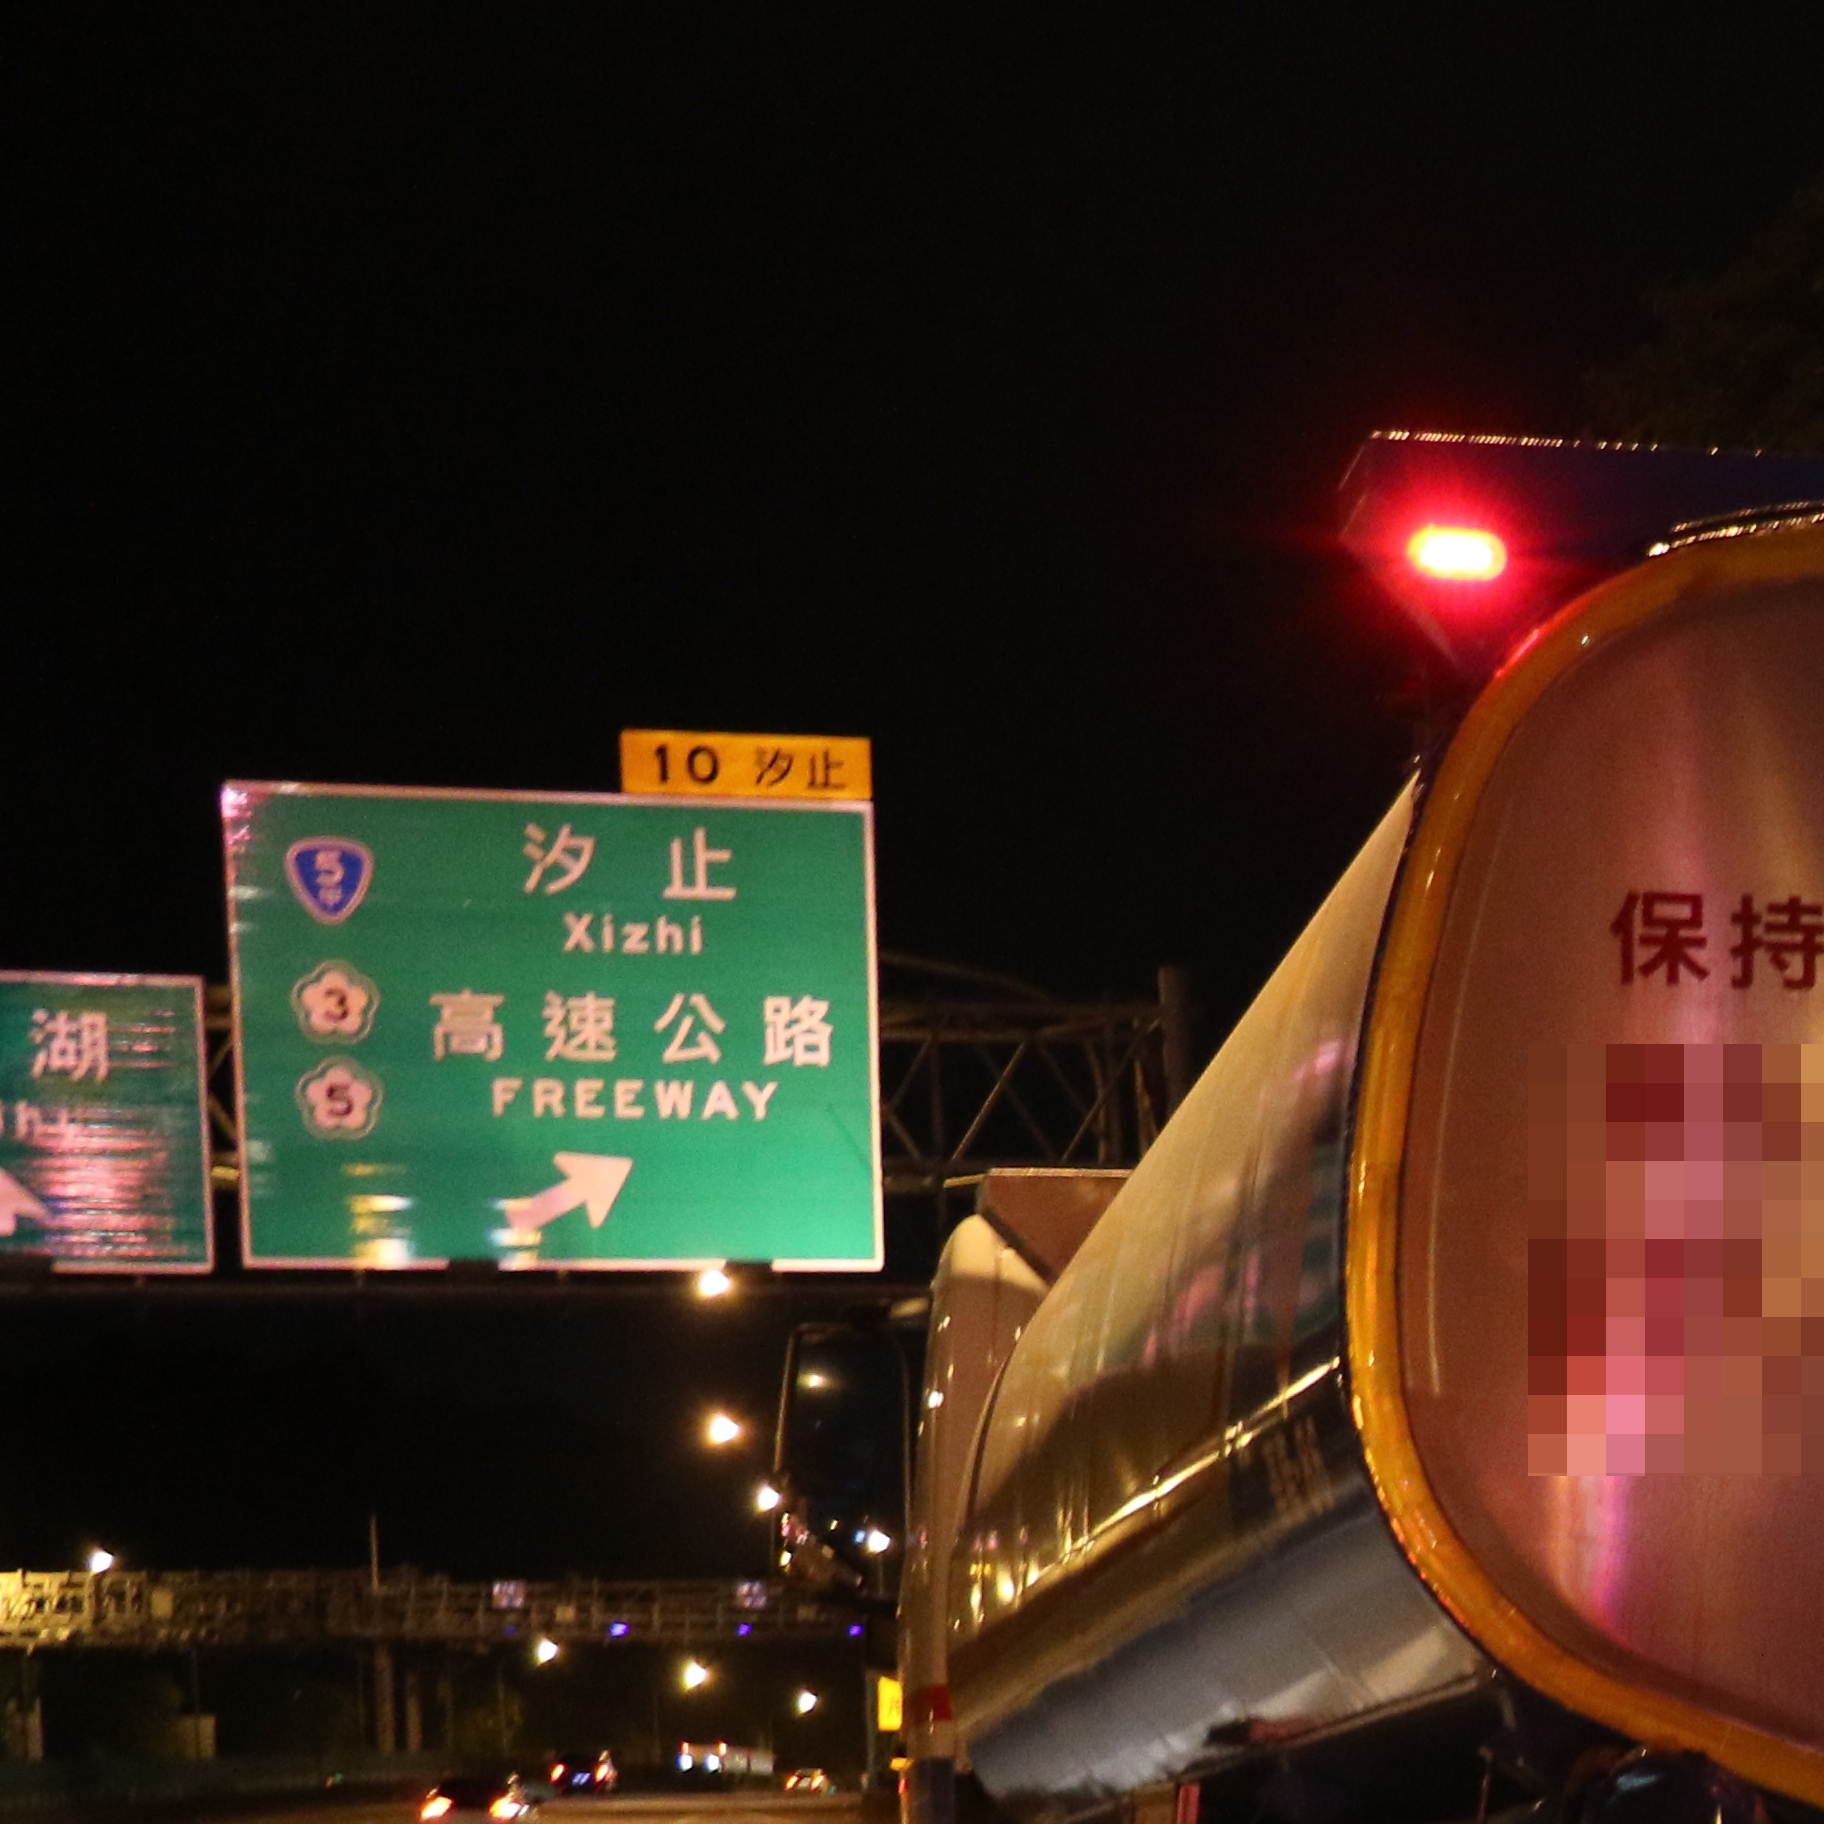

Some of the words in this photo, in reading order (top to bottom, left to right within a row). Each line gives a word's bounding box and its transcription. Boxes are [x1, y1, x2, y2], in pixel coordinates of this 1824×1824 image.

[655, 744, 720, 785] 10
[754, 747, 846, 790] 汐止
[522, 822, 738, 900] 汐止
[563, 911, 705, 955] Xizhi
[324, 988, 349, 1022] 3
[429, 987, 834, 1067] 高速公路
[29, 1008, 110, 1083] 湖
[326, 1084, 354, 1117] 5
[491, 1076, 780, 1122] FREEWAY
